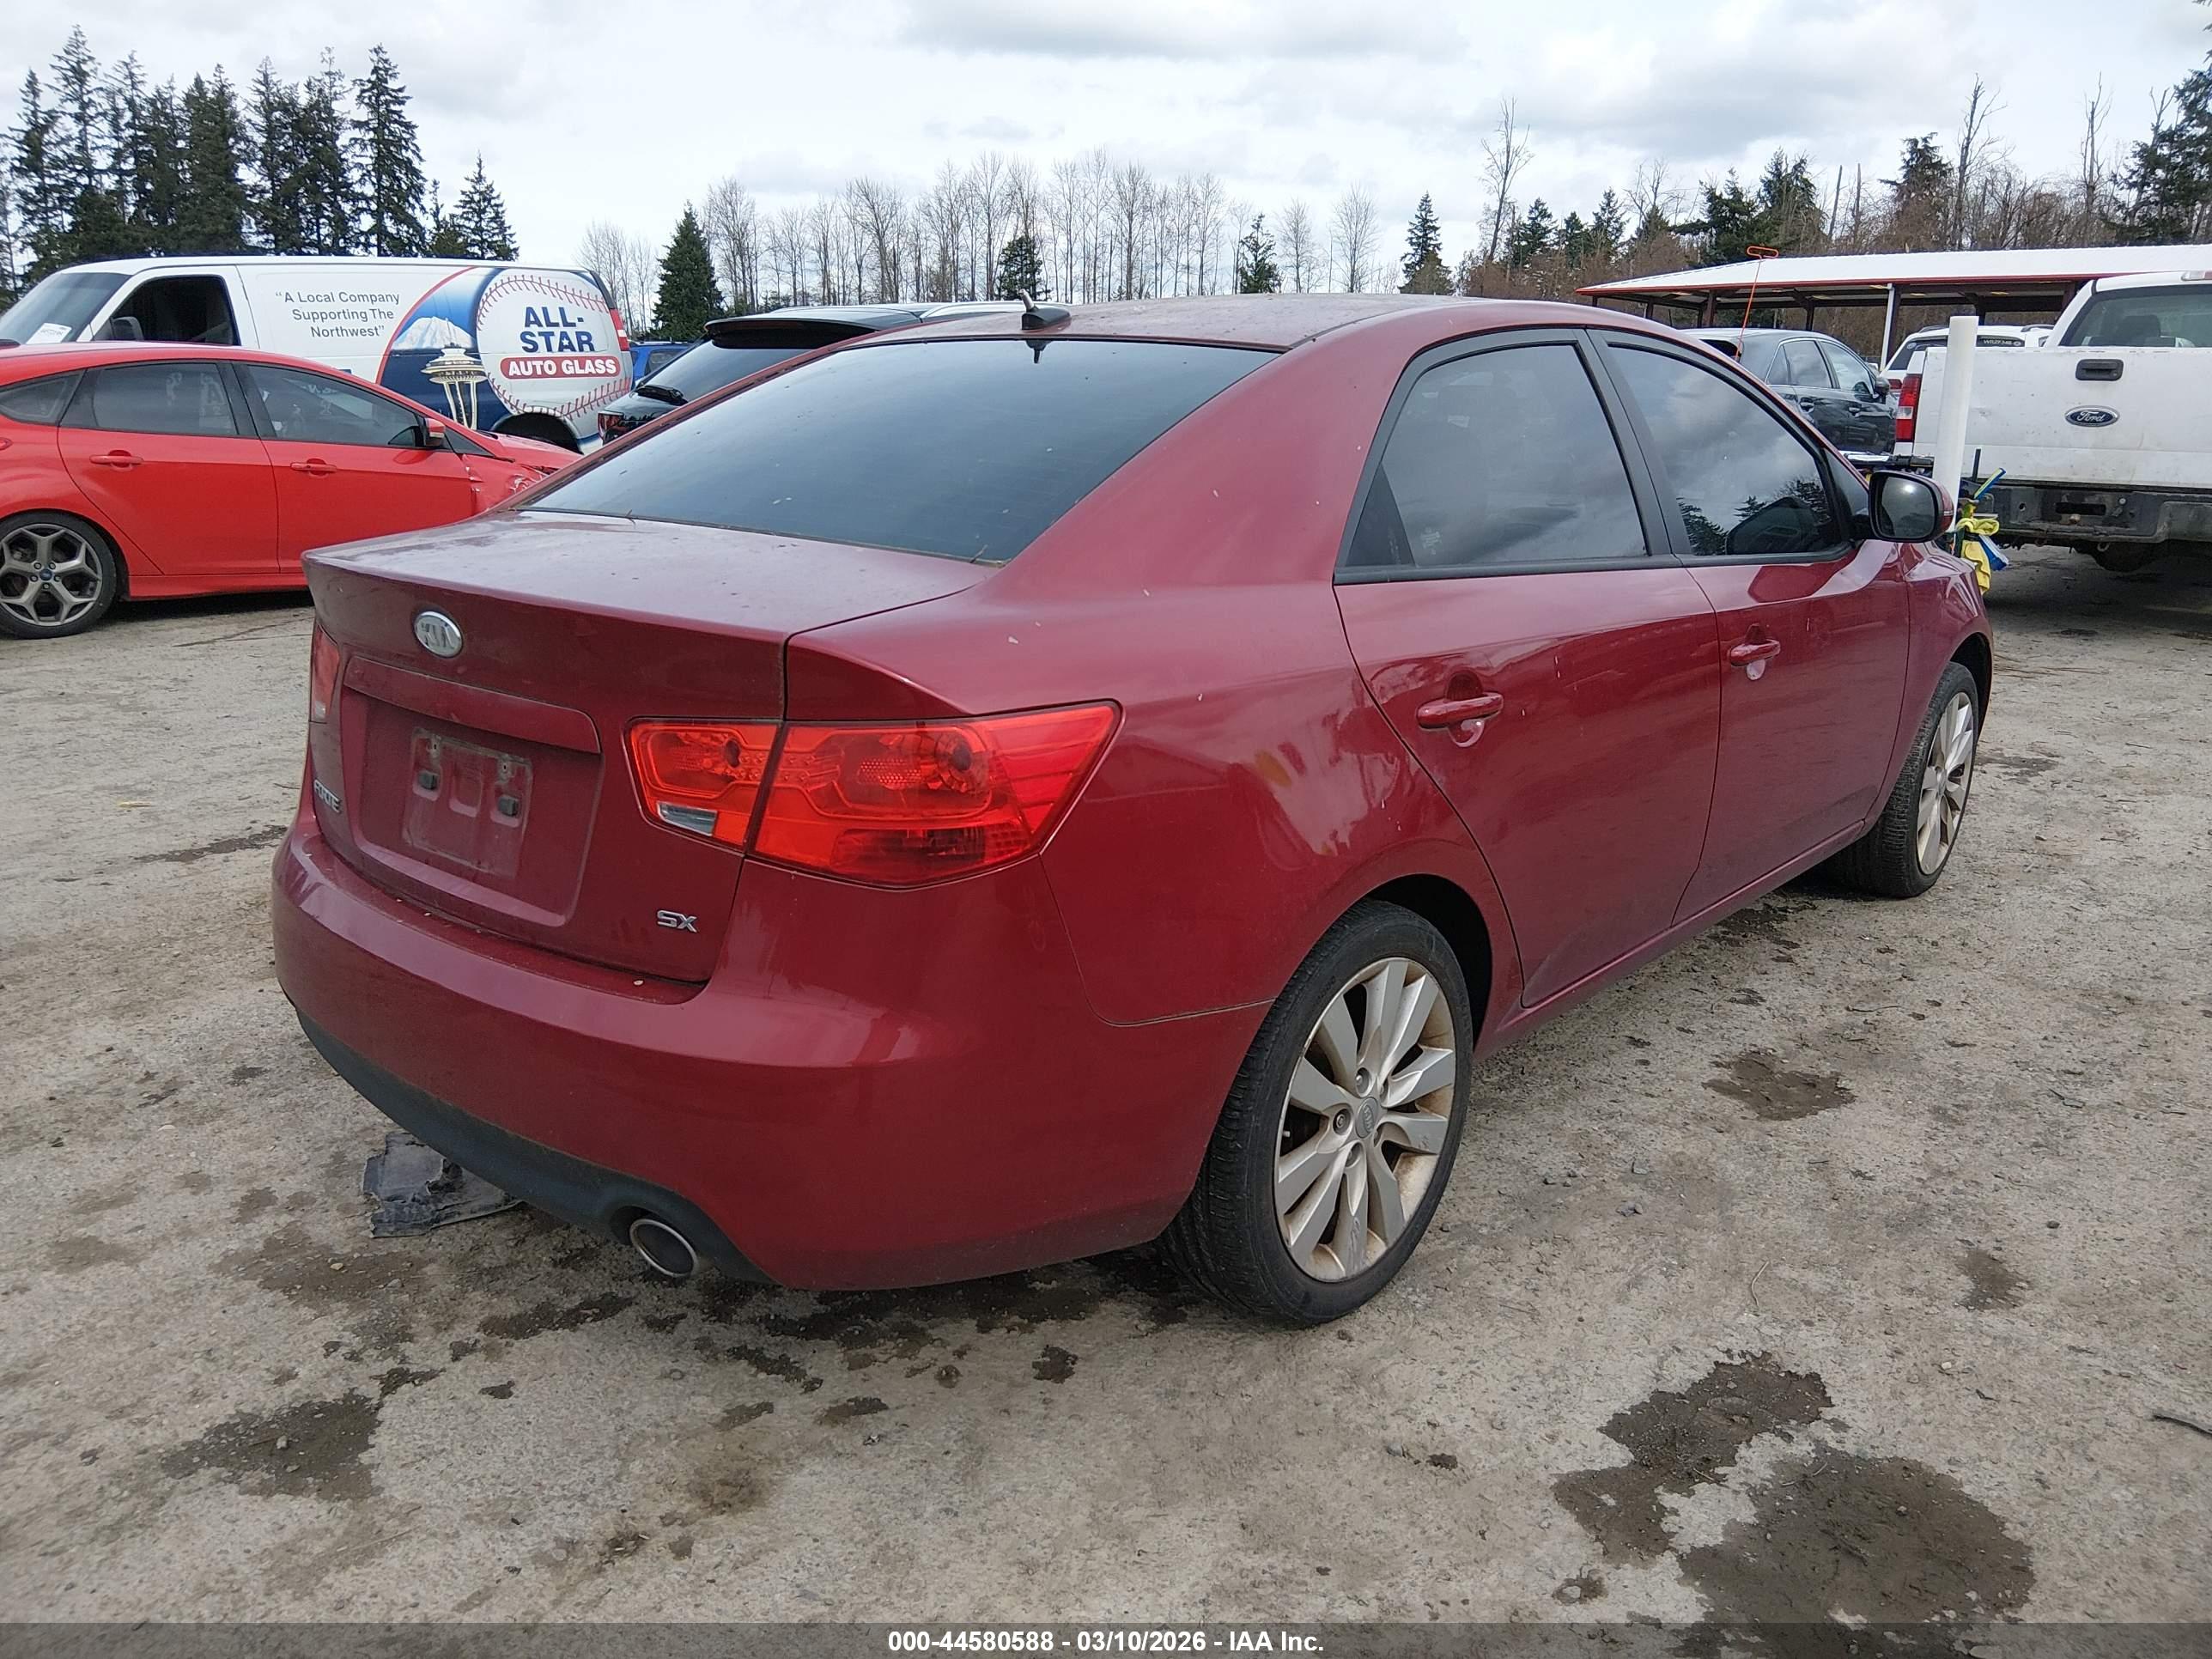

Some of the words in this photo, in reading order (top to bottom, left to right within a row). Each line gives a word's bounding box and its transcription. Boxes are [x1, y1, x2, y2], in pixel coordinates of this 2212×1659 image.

[297, 291, 335, 303] Local
[338, 291, 399, 305] Company
[292, 308, 368, 323] Supporting
[369, 308, 394, 319] The
[524, 306, 584, 328] ALL-
[520, 331, 595, 353] STAR
[508, 360, 557, 376] AUTO
[561, 359, 617, 374] GLASS
[657, 909, 697, 933] SX
